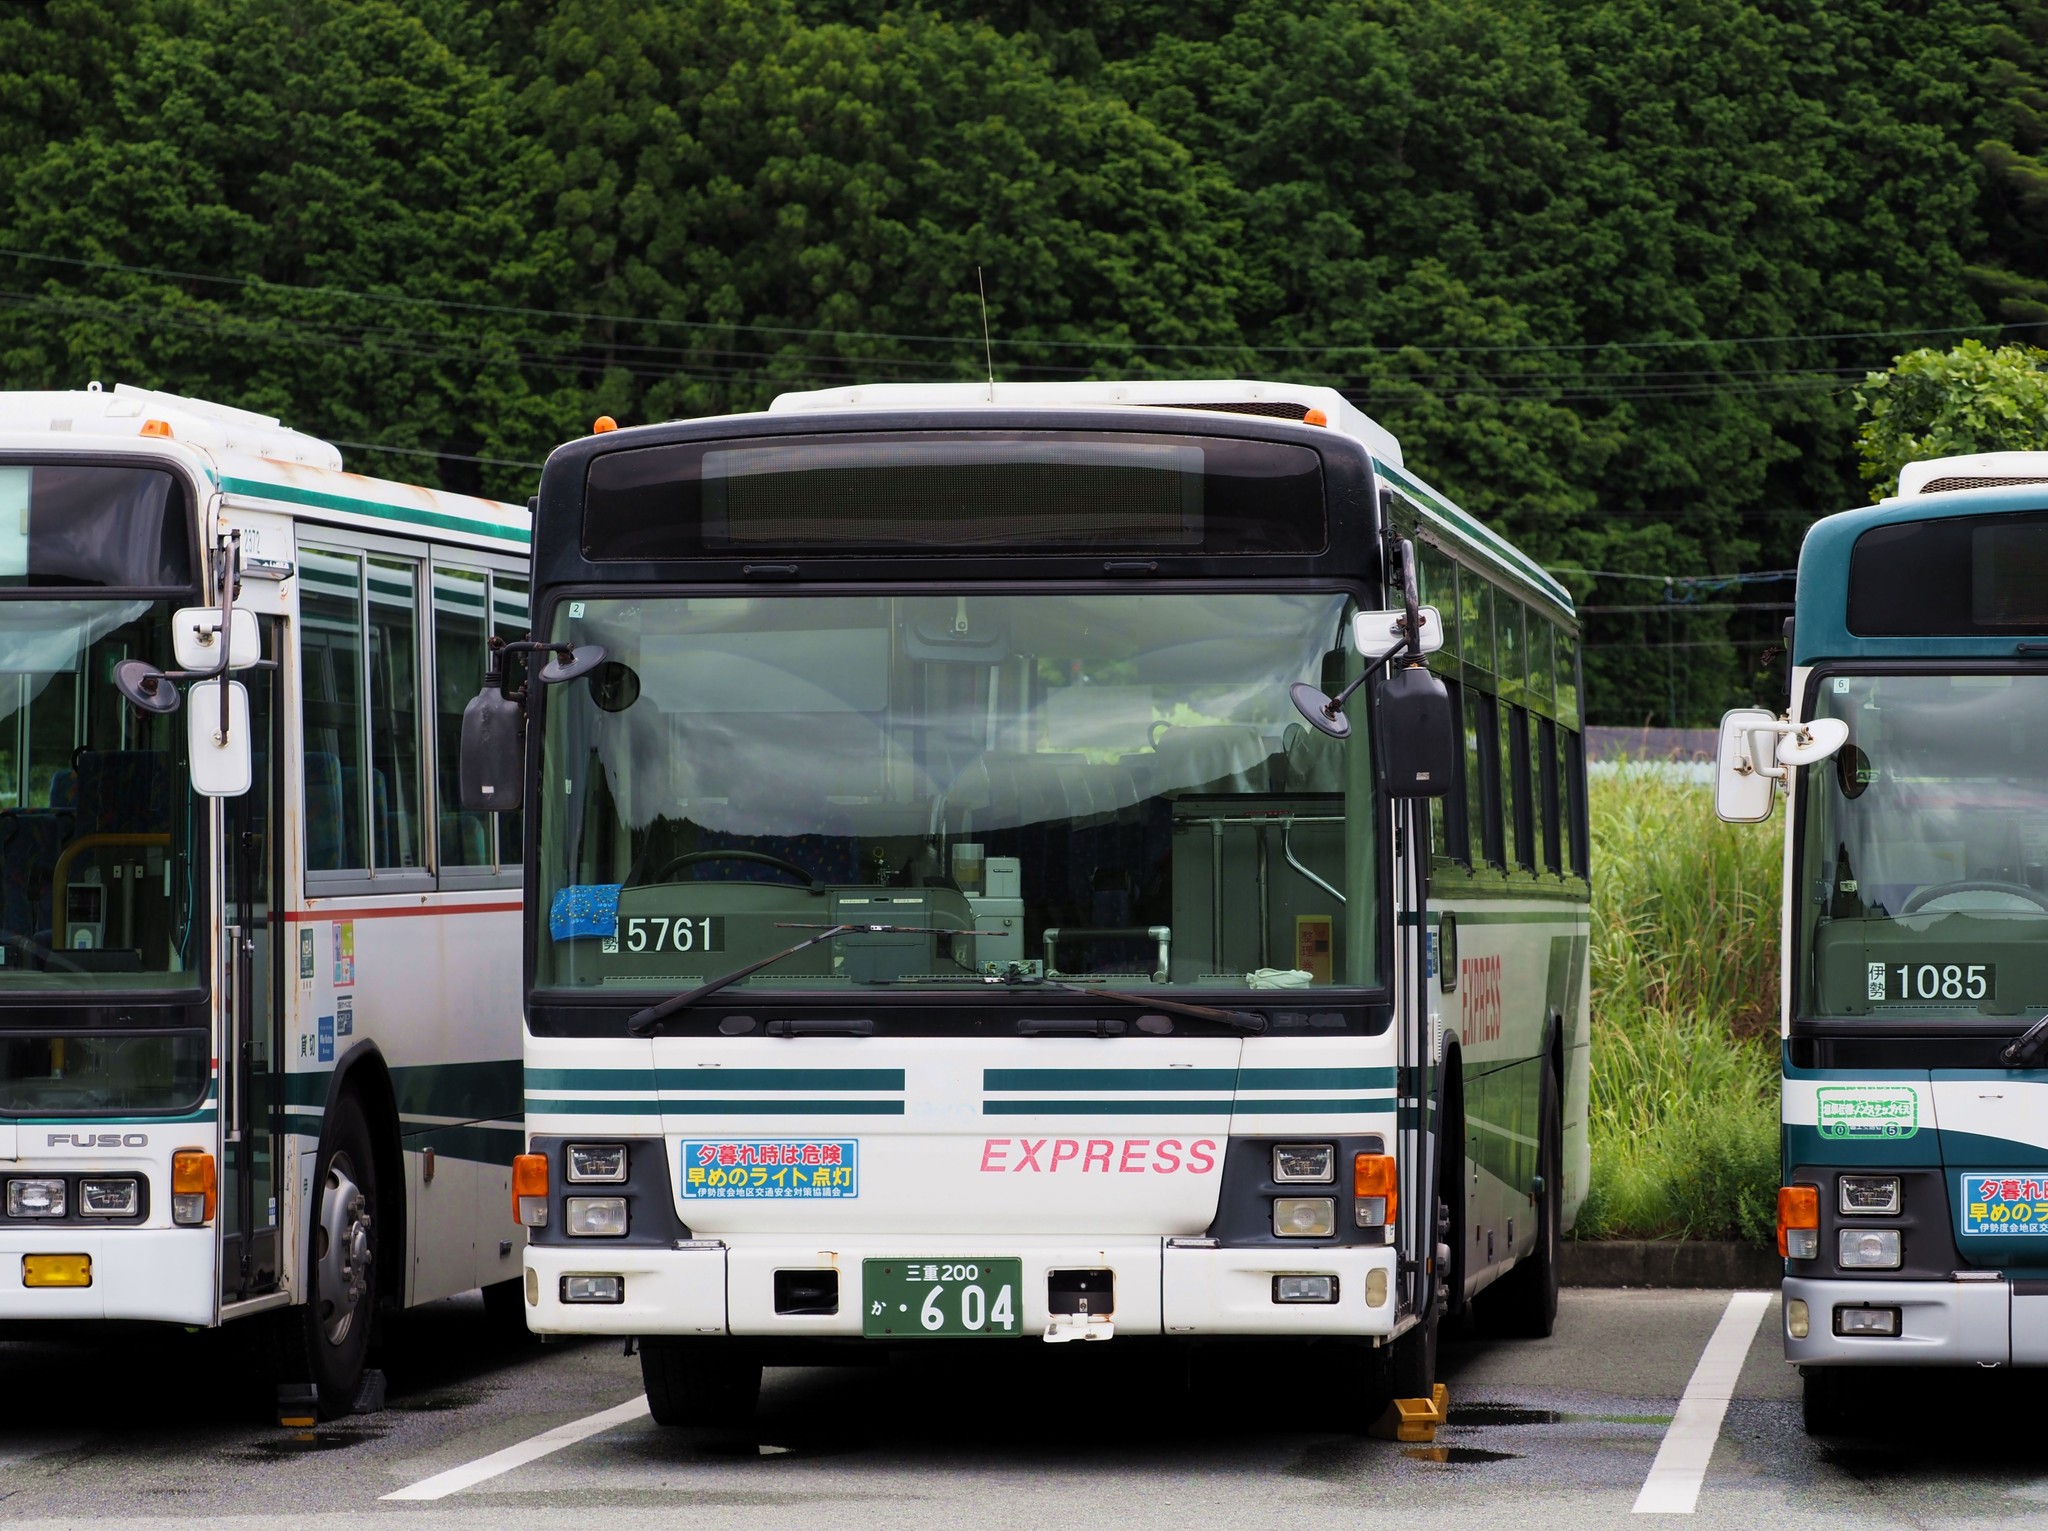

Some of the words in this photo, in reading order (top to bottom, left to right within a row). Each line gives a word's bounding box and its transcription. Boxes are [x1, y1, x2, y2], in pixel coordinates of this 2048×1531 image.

[627, 917, 711, 952] 5761
[1869, 965, 1886, 998] 伊勢
[1896, 964, 1987, 999] 1085
[1462, 954, 1501, 1046] EXPRESS
[47, 1133, 149, 1148] FUSO
[697, 1144, 842, 1166] 夕暮れ時は危険
[979, 1139, 1217, 1174] EXPRESS
[697, 1187, 841, 1198] 伊勢度会地区交通安全対策協議会
[1979, 1179, 2048, 1201] 夕暮れ
[871, 1300, 887, 1316] か
